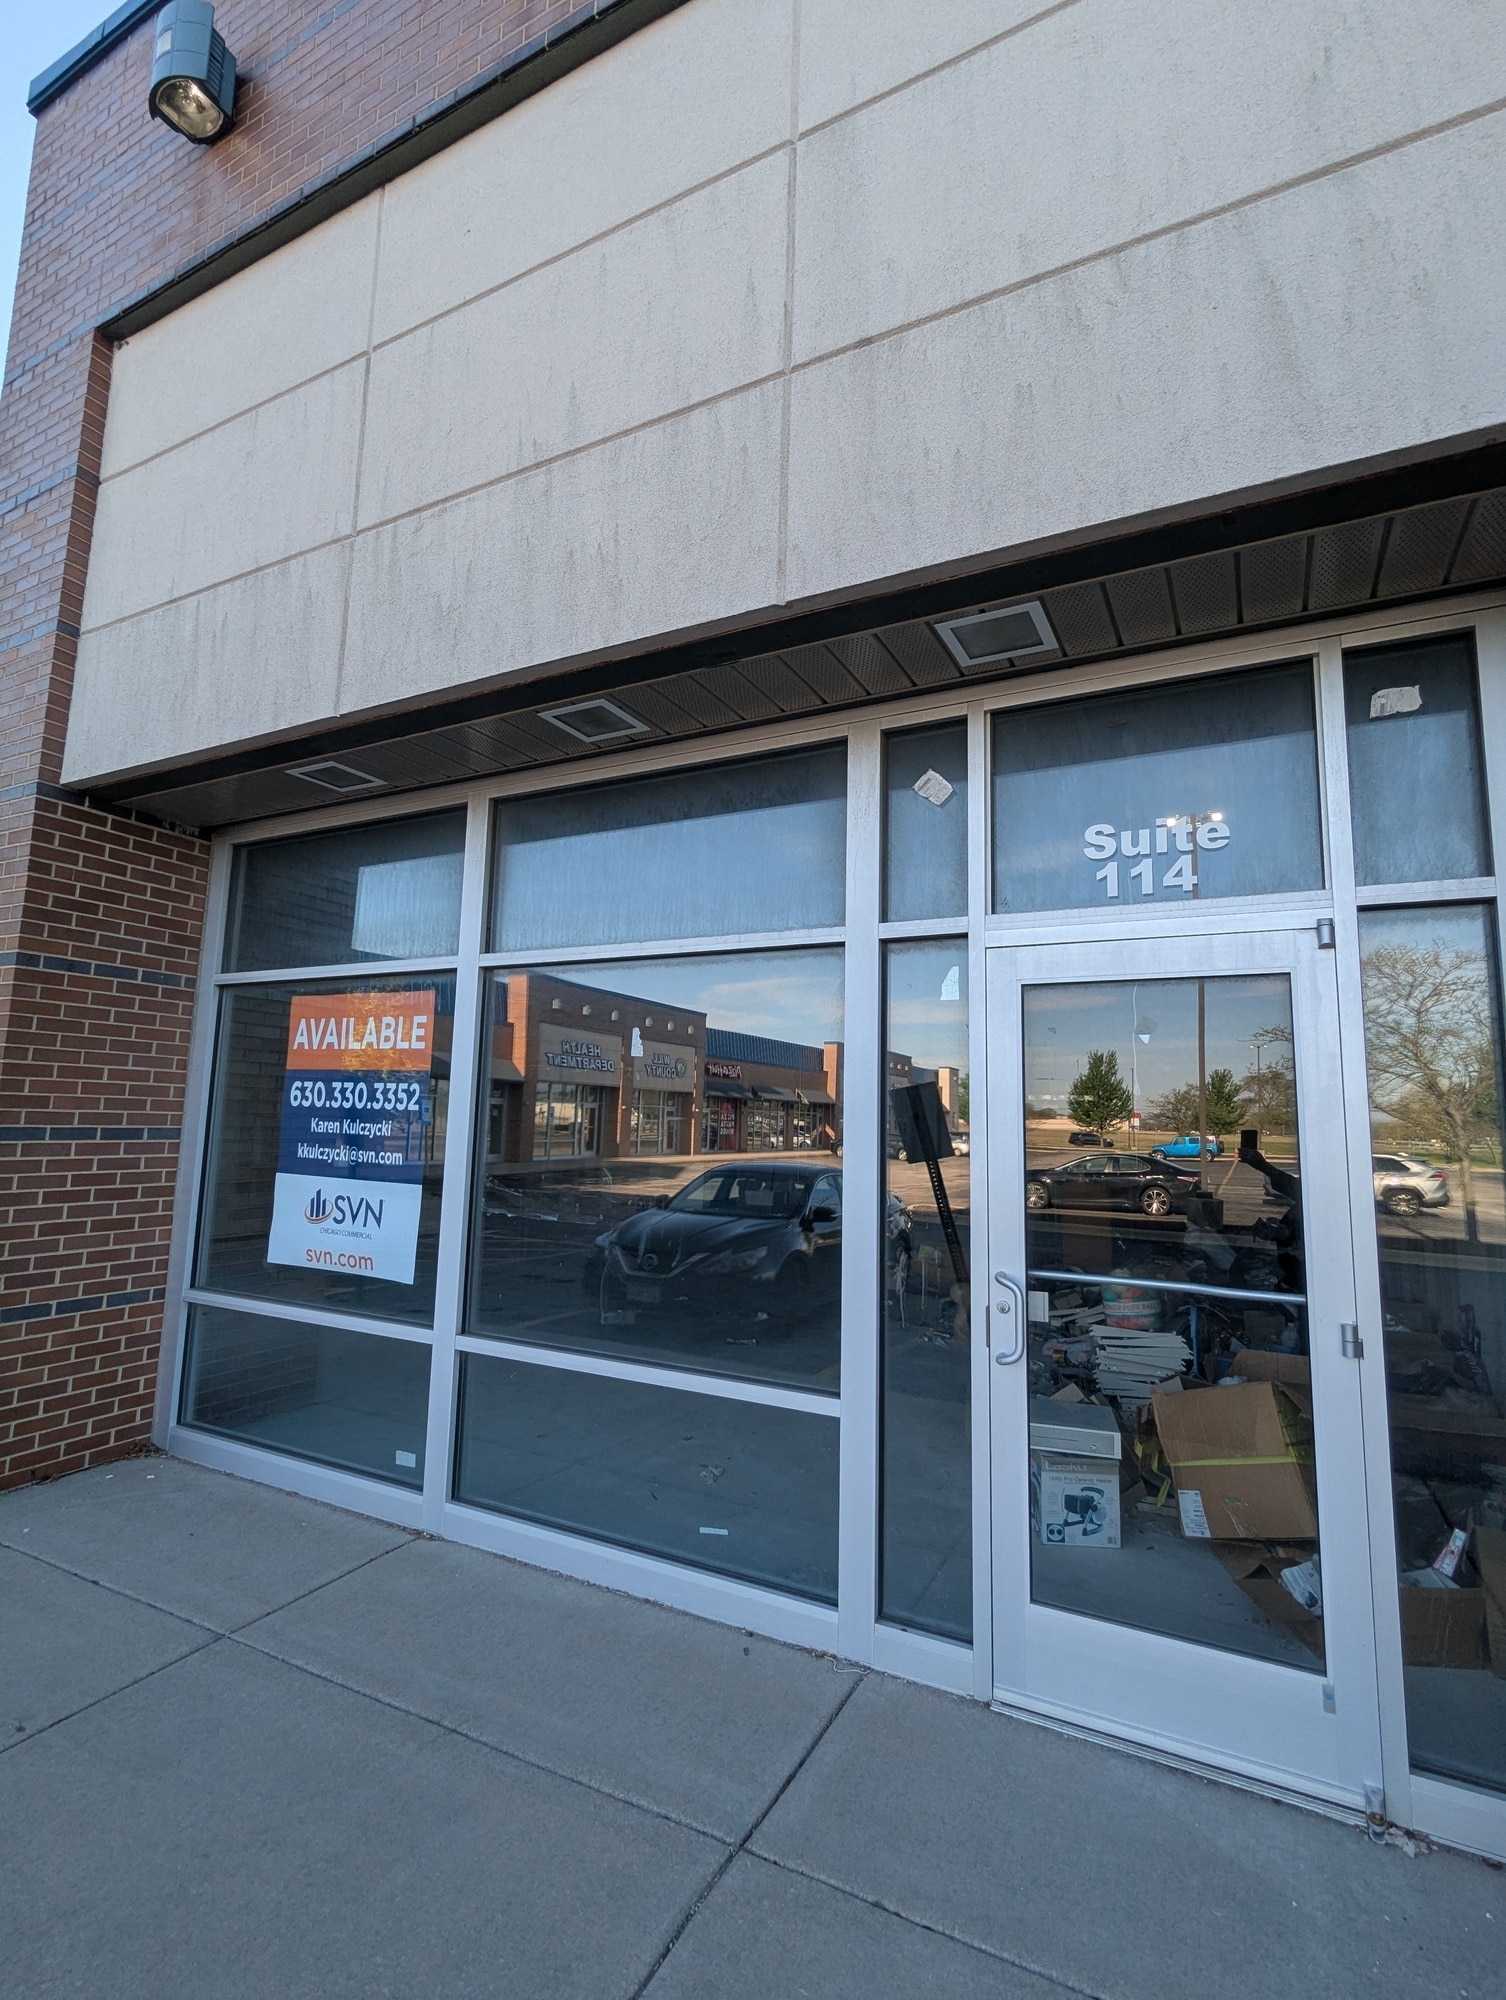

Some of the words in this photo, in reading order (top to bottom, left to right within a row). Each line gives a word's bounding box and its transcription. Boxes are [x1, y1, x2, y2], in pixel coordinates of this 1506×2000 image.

[1083, 816, 1230, 860] Suite
[1096, 854, 1198, 898] 114
[293, 1015, 428, 1050] AVAILABLE
[290, 1081, 420, 1111] 630.330.3352
[310, 1117, 340, 1134] Karen
[342, 1118, 392, 1138] Kulczycki
[297, 1142, 403, 1166] kkulczycki@svn.com
[333, 1195, 384, 1230] SVN
[319, 1226, 341, 1237] CHICAGO
[341, 1229, 373, 1241] COMMERCIAL
[306, 1247, 374, 1271] svn.com
